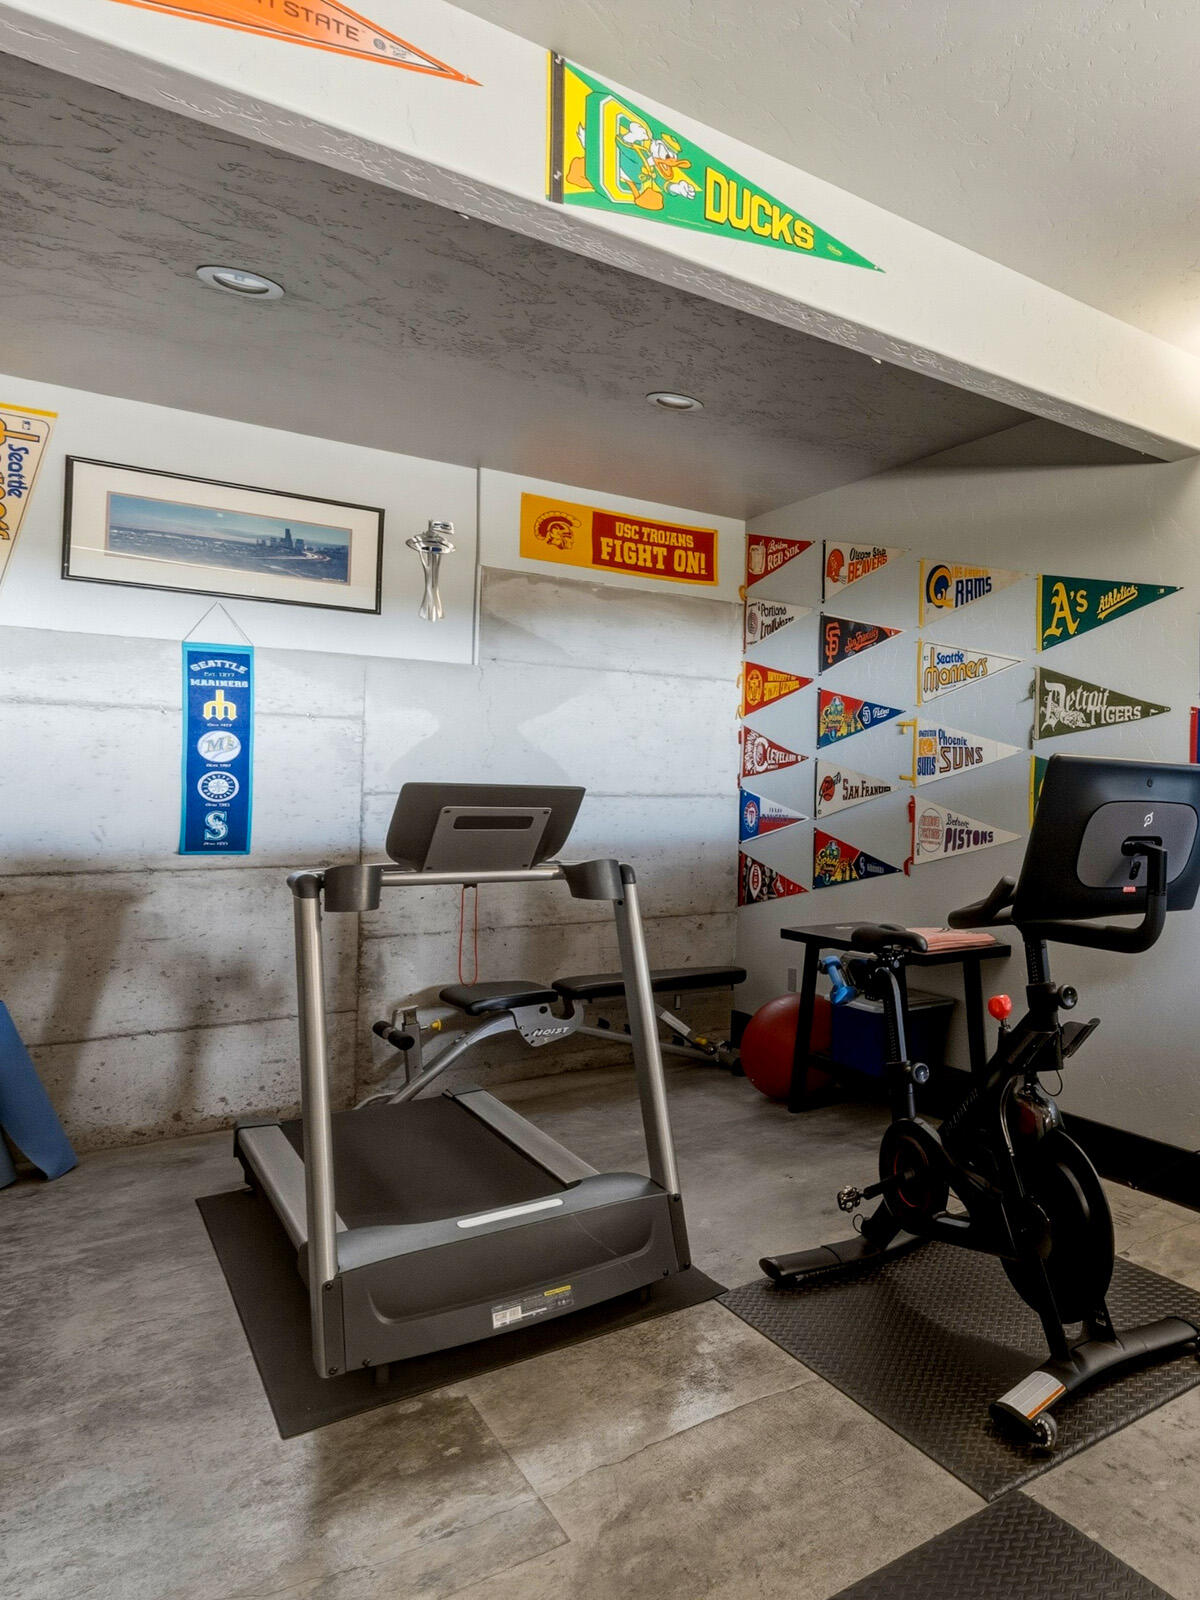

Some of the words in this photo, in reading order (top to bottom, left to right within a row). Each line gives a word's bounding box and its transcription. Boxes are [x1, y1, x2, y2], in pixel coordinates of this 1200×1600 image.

[284, 0, 360, 42] STATE
[704, 166, 815, 251] DUCKS
[7, 443, 30, 499] Seattle
[614, 521, 640, 540] USC
[641, 527, 695, 548] TROJANS
[600, 537, 668, 570] FIGHT
[673, 549, 707, 575] ON!
[767, 551, 784, 570] RED
[847, 554, 888, 584] BEAVERS
[954, 576, 992, 608] RAMS
[189, 659, 249, 674] SEATTLE
[936, 650, 965, 665] Seattle
[189, 678, 249, 688] MARINERS
[1040, 680, 1110, 732] Detroit
[1086, 705, 1142, 725] TIGERS
[938, 728, 968, 746] Phoenix
[939, 746, 984, 774] SUNS
[943, 827, 994, 853] PISTONS
[532, 1026, 570, 1037] HOIST
